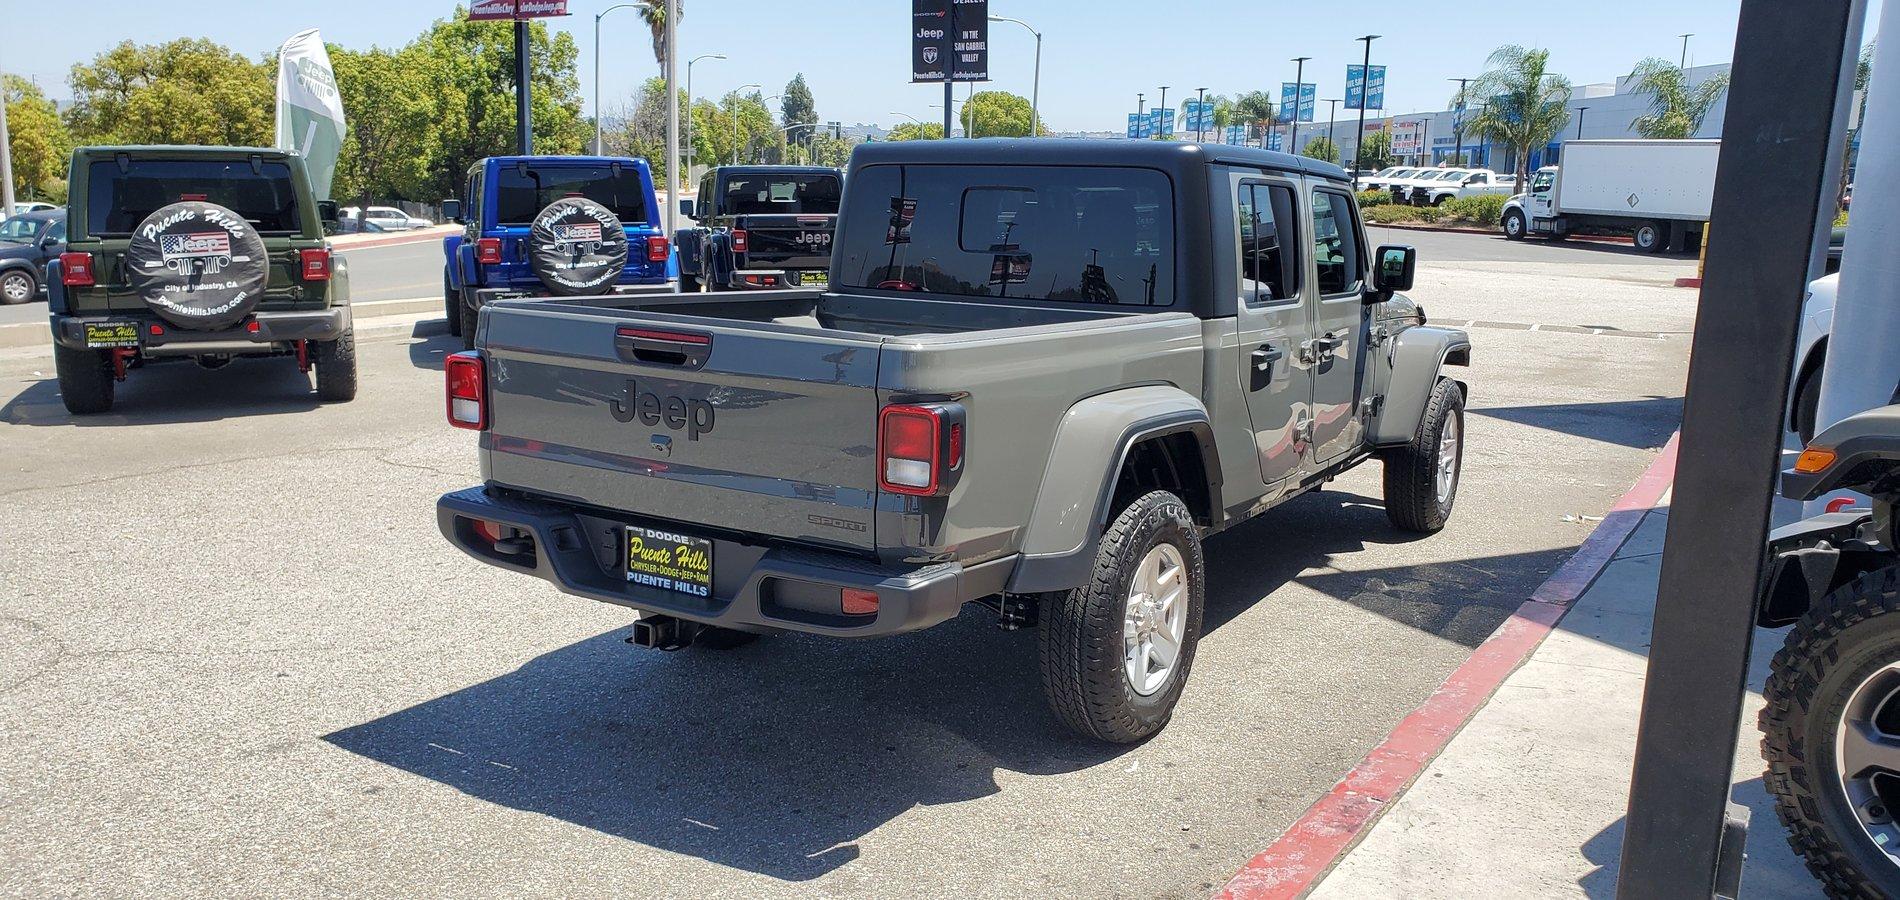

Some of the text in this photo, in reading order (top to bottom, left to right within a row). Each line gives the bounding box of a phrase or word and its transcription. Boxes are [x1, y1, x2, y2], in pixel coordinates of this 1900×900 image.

[917, 28, 944, 39] Jeep
[963, 30, 978, 39] IN THE
[954, 42, 986, 51] SAN GABRIEL
[961, 54, 979, 62] VALLEY
[304, 63, 332, 83] Jeep
[143, 209, 246, 242] Puente Hills
[542, 205, 614, 231] Puente Hills
[563, 227, 593, 239] Jeep
[796, 231, 830, 245] Jeep
[173, 237, 219, 253] Jeep
[165, 285, 180, 293] City
[159, 290, 247, 316] PuenteHillsJeep.com
[609, 379, 715, 441] Jeep
[808, 514, 867, 532] SPORT
[647, 529, 689, 544] DODGE
[631, 536, 708, 571] Puente Hills
[627, 571, 708, 596] PUENTE HILLS
